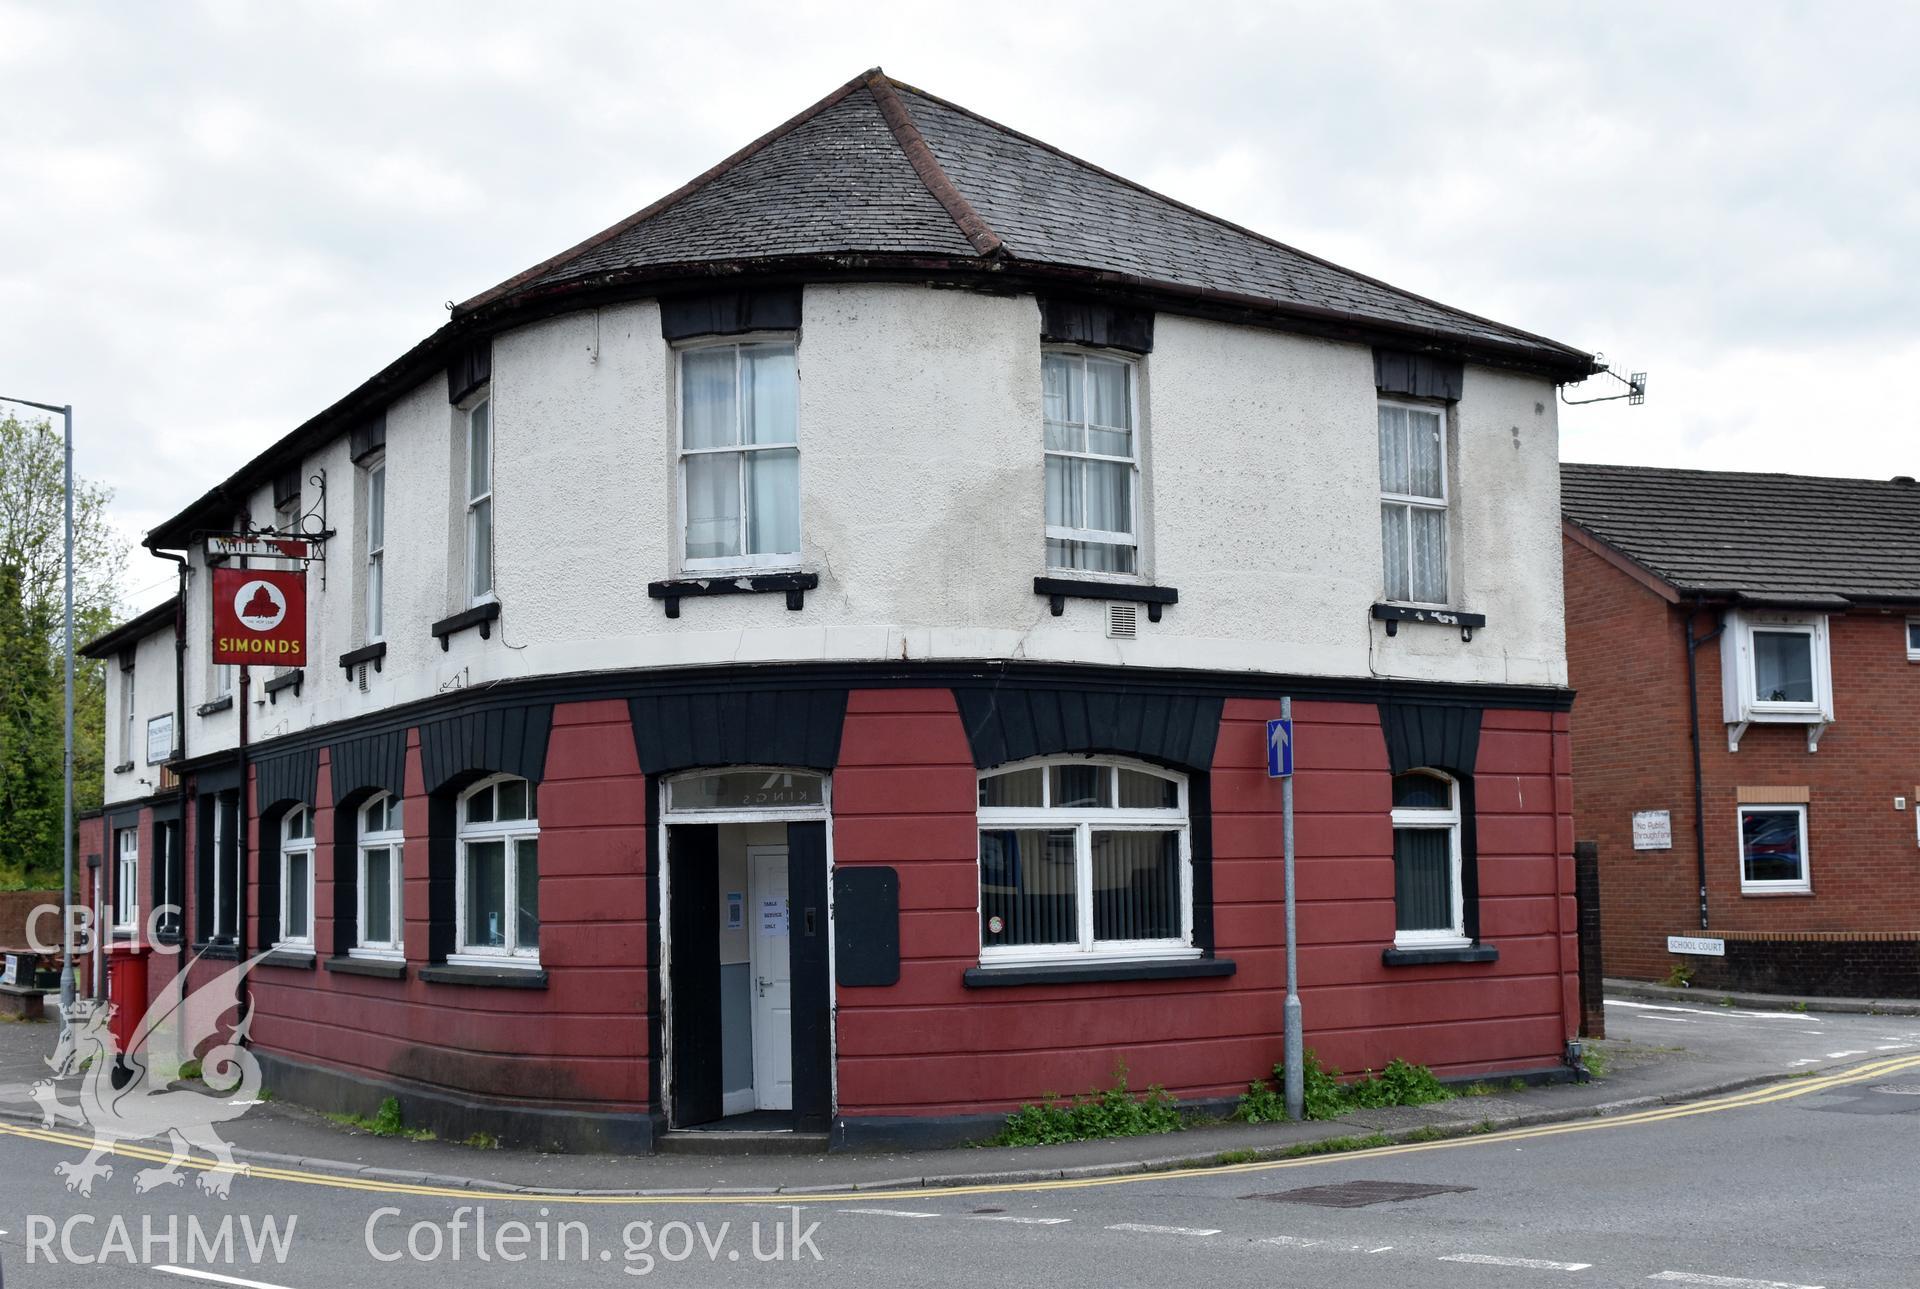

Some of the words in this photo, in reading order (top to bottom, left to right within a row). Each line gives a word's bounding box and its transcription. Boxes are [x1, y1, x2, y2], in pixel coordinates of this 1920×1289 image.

[215, 540, 257, 553] WHITE
[219, 638, 300, 654] SIMONDS
[1670, 940, 1697, 950] SCHOOL
[1698, 942, 1722, 952] COURT
